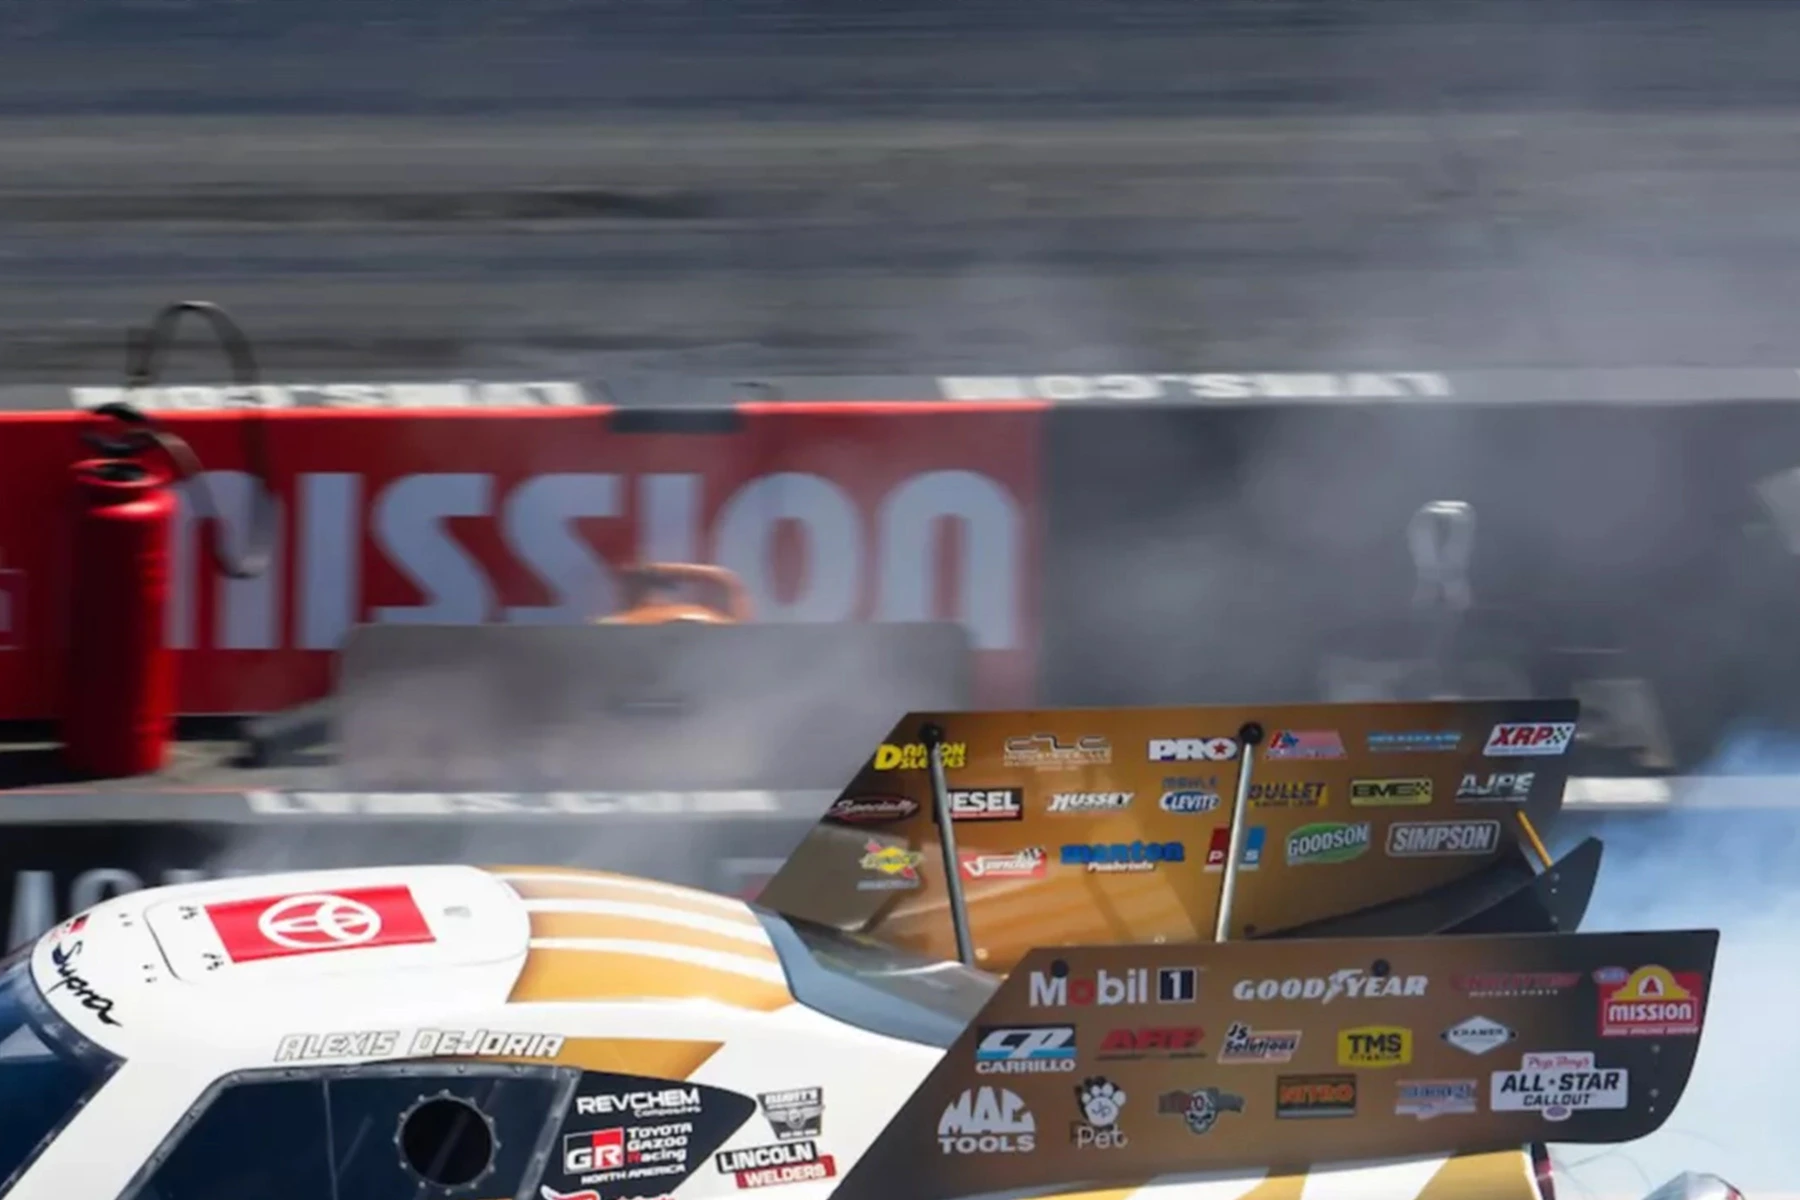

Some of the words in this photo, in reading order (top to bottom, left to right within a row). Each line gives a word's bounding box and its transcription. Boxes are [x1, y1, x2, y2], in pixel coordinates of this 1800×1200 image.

[1491, 727, 1555, 746] XRP
[1149, 738, 1237, 761] PRO
[1457, 773, 1534, 796] AJPE
[1047, 792, 1134, 812] HUSSEY
[1160, 791, 1220, 813] CLEVITE
[1287, 824, 1369, 858] GOODSON
[1394, 826, 1493, 850] SIMPSON
[45, 940, 124, 1028] Supra
[1028, 968, 1148, 1007] Mobil
[1233, 968, 1429, 1004] GOODYEAR
[1609, 1003, 1693, 1022] MISSION
[1228, 1023, 1248, 1039] JS
[274, 1031, 400, 1062] ALEXIS
[1224, 1037, 1295, 1057] Solutions
[1347, 1034, 1402, 1054] TMS
[976, 1059, 1076, 1073] CARRILLO
[1500, 1072, 1546, 1093] ALL
[1558, 1072, 1620, 1092] STAR
[577, 1089, 701, 1115] REVCHEM
[1523, 1093, 1591, 1107] CALLOUT
[938, 1086, 1035, 1136] MAC
[628, 1123, 693, 1140] TOYOTA
[1076, 1122, 1128, 1149] Pet
[627, 1136, 688, 1151] GAZOO
[939, 1135, 1035, 1154] TOOLS
[567, 1144, 622, 1171] GR
[627, 1148, 687, 1166] Racing
[721, 1144, 813, 1173] LINCOLN
[581, 1171, 627, 1185] NORTH
[630, 1164, 686, 1179] AMERICA
[745, 1165, 827, 1186] WELDERS
